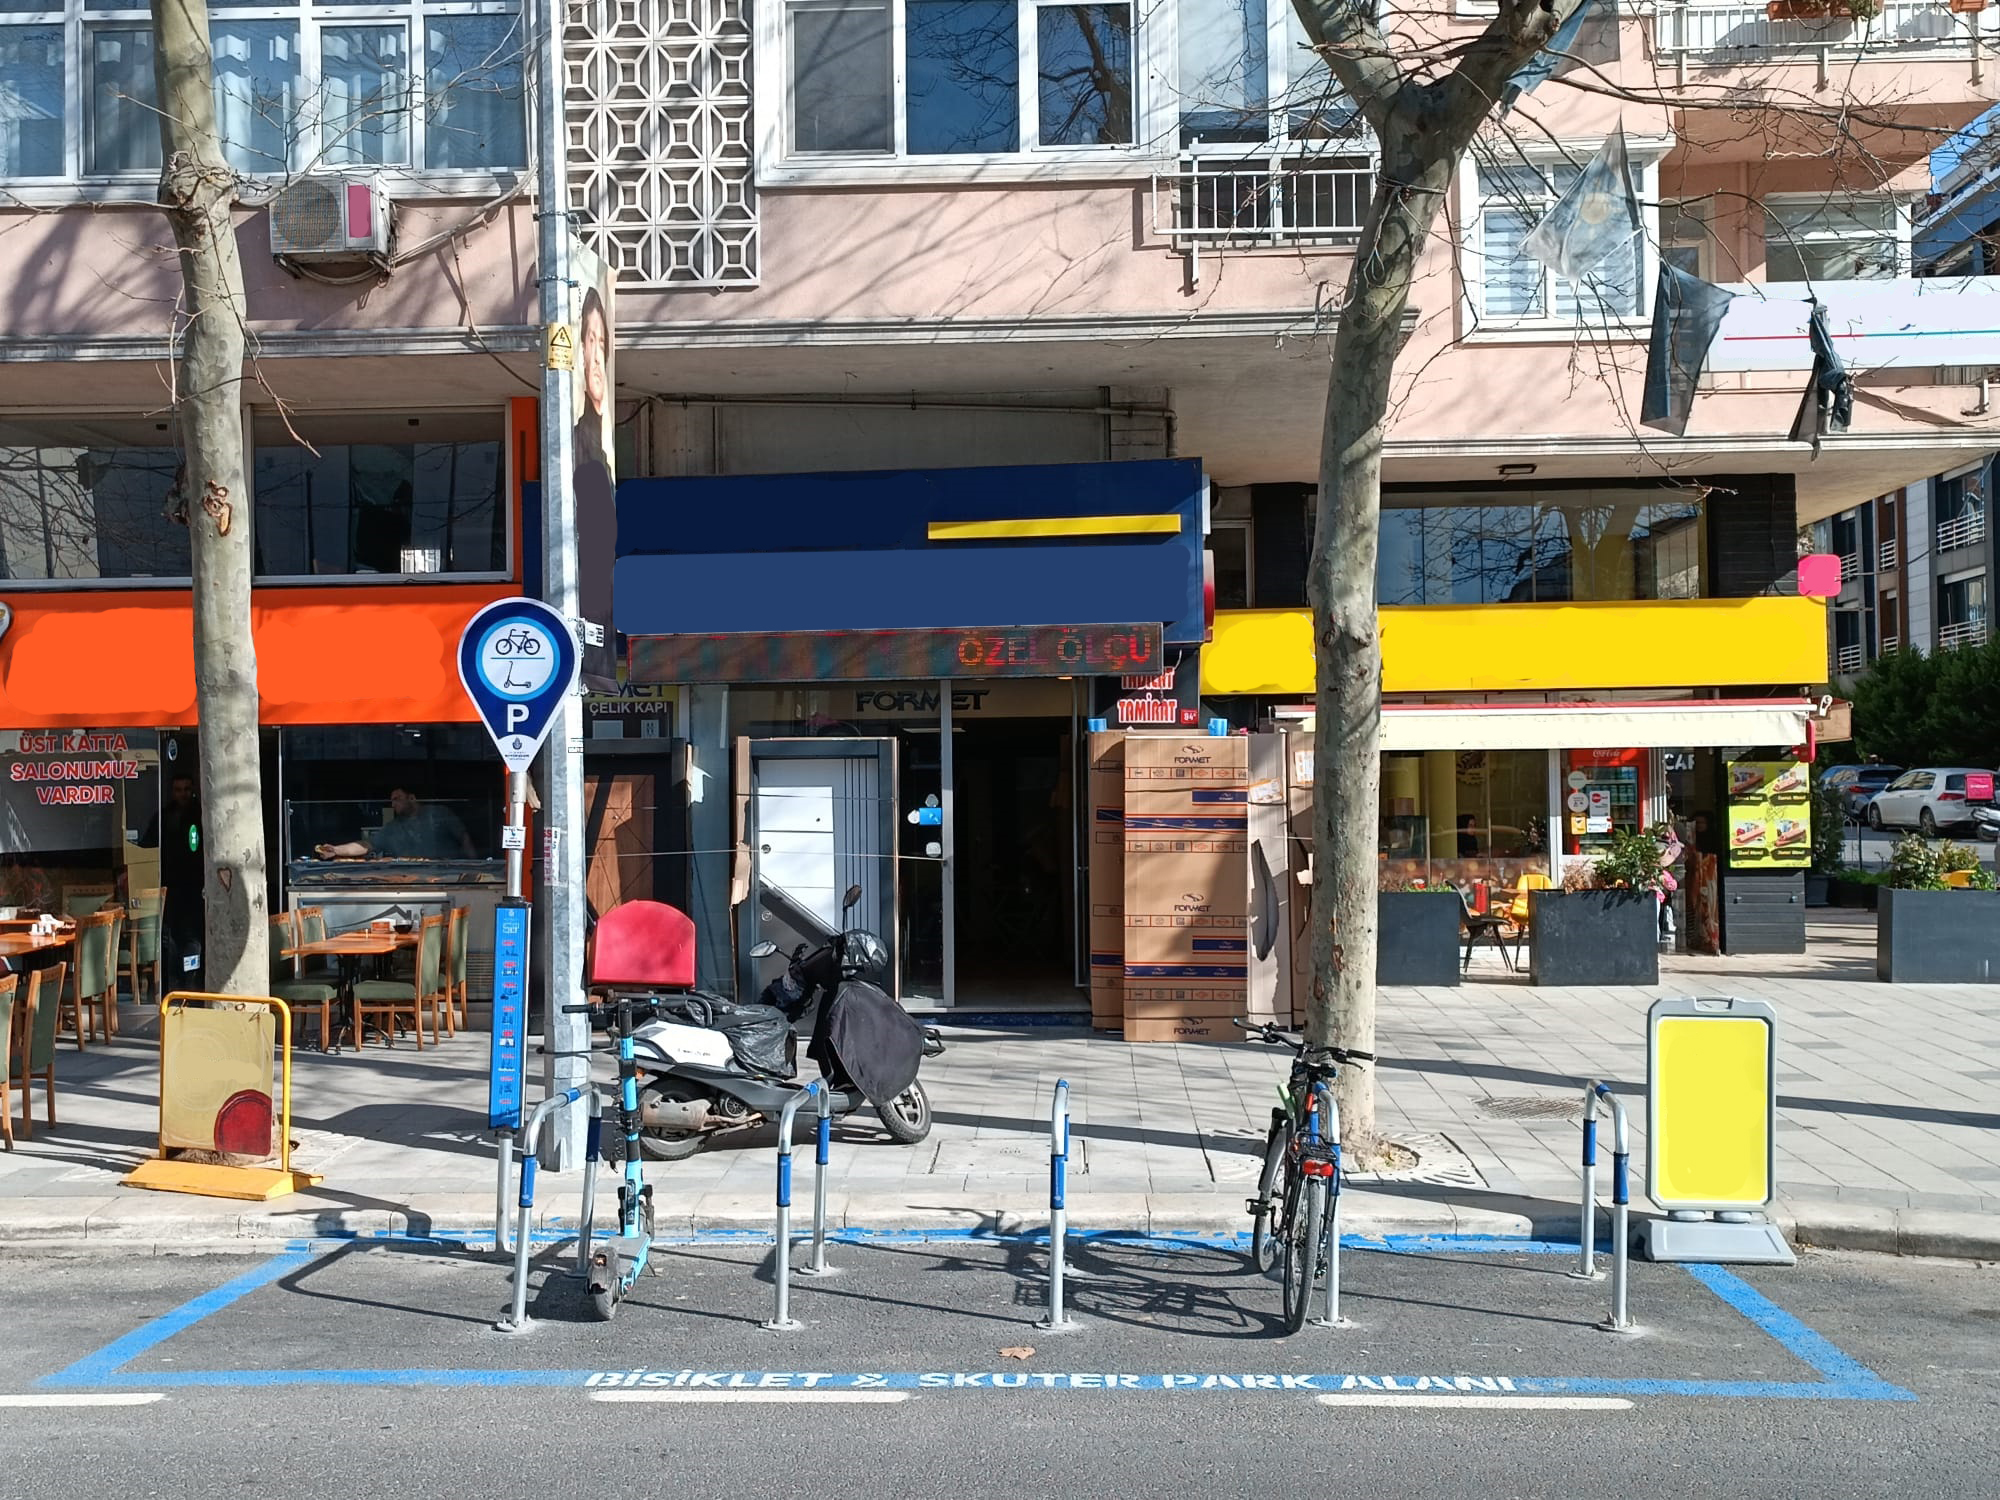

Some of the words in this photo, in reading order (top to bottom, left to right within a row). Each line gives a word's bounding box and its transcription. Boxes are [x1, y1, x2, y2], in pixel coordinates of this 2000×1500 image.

[958, 631, 1049, 666] ÖZEL
[1057, 626, 1151, 670] ÖLÇÜ
[589, 701, 631, 716] ÇELİK
[634, 702, 668, 713] KAPI
[856, 688, 991, 712] FORMET
[1117, 692, 1177, 723] TAMİRAT
[507, 703, 530, 733] P
[20, 731, 58, 754] ÜST
[63, 733, 128, 753] KATTA
[11, 760, 139, 781] SALONUMUZ
[1174, 756, 1212, 764] FORMET
[36, 785, 115, 805] VARDIR
[1174, 904, 1212, 912] FORMET
[1173, 1027, 1211, 1035] FORMET
[584, 1367, 833, 1388] BİSİKLET
[851, 1373, 888, 1388] &
[918, 1373, 1140, 1389] SKUTER
[1163, 1374, 1321, 1390] PARK
[1341, 1375, 1517, 1392] ALANI
